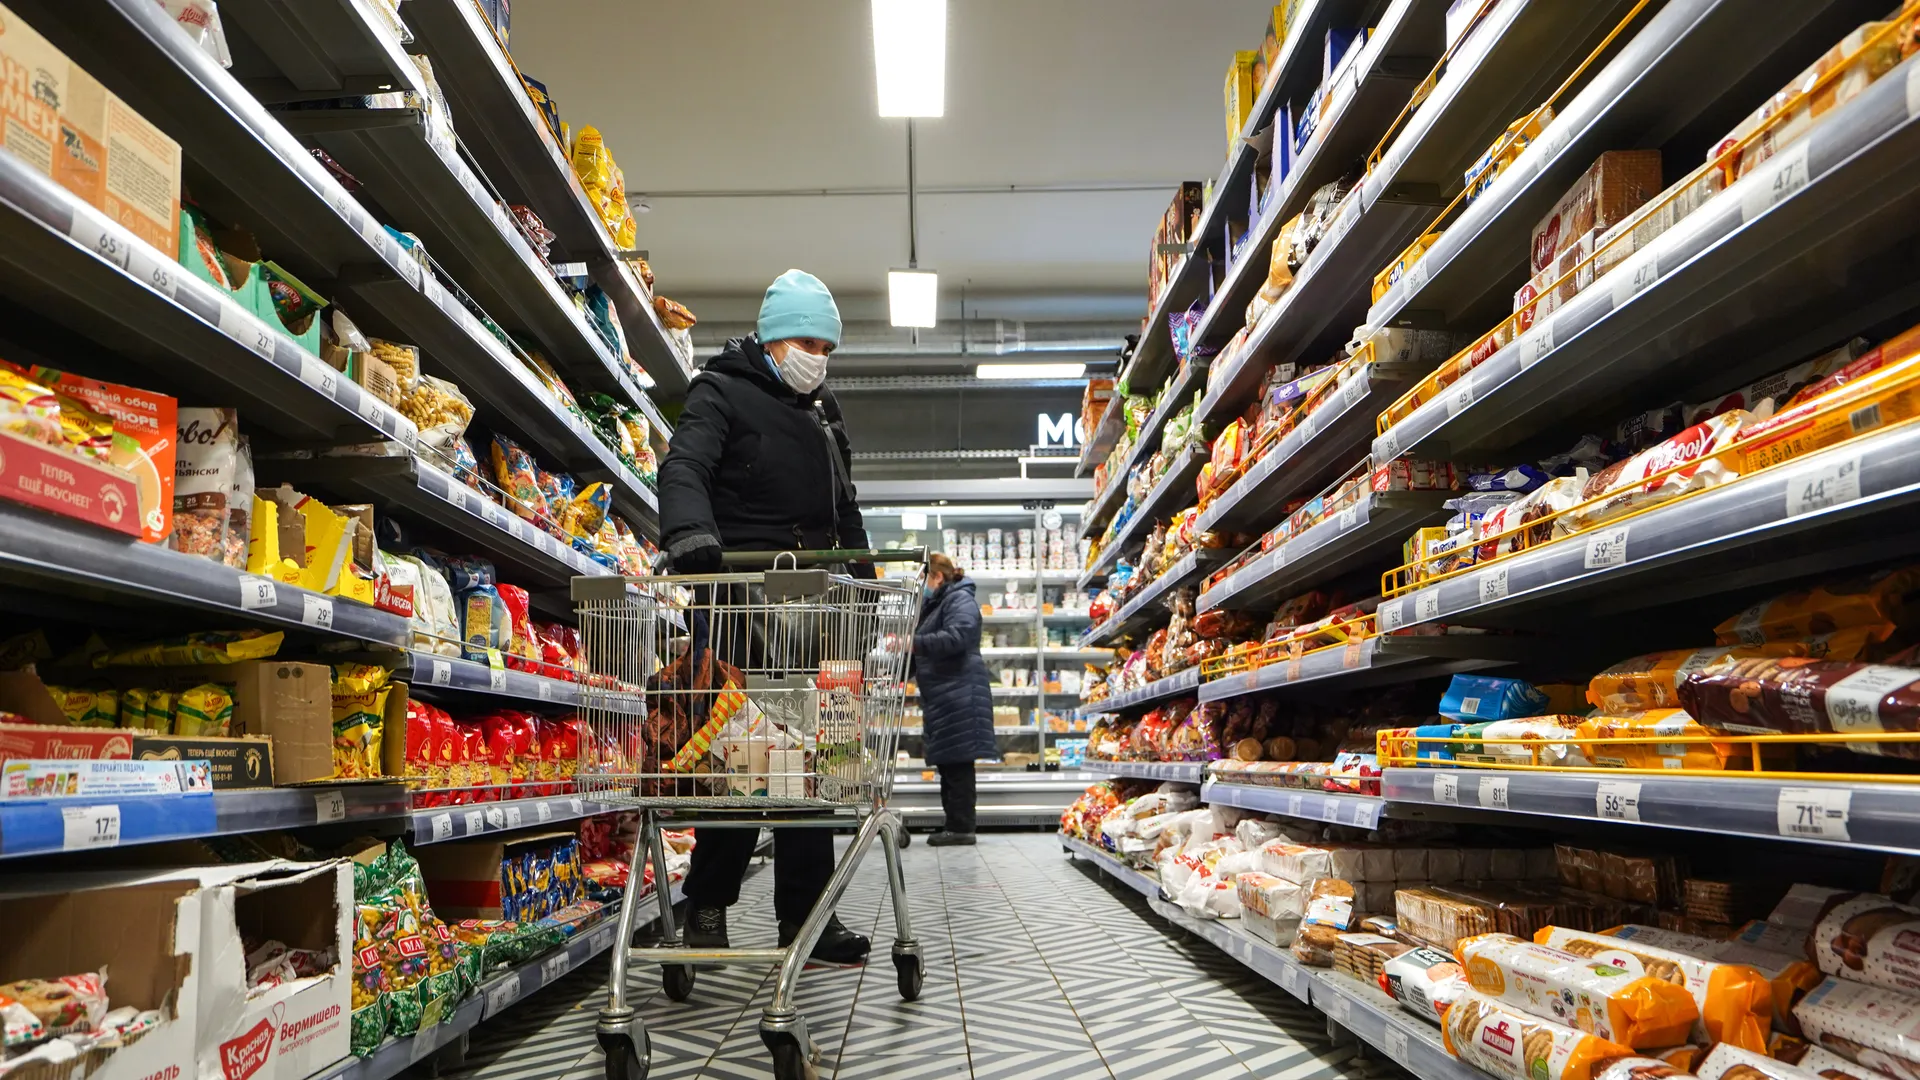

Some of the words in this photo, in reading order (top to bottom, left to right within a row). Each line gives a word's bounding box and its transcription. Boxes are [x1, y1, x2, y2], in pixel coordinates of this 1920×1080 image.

[1773, 165, 1792, 192] 47
[99, 233, 117, 254] 65
[152, 267, 168, 287] 65
[1633, 264, 1647, 285] 47
[257, 332, 268, 348] 27
[322, 374, 332, 389] 27
[40, 462, 76, 486] ТЕПЕРЬ
[1802, 479, 1825, 502] 44
[1594, 542, 1608, 558] 59
[258, 585, 269, 598] 87
[1486, 579, 1495, 594] 55
[317, 608, 327, 621] 29
[1493, 787, 1502, 800] 81
[1605, 795, 1619, 811] 56
[1796, 805, 1813, 825] 71
[96, 817, 109, 834] 17
[280, 1003, 341, 1041] Вермишель
[227, 1028, 270, 1066] Красная
[230, 1054, 256, 1080] Цена
